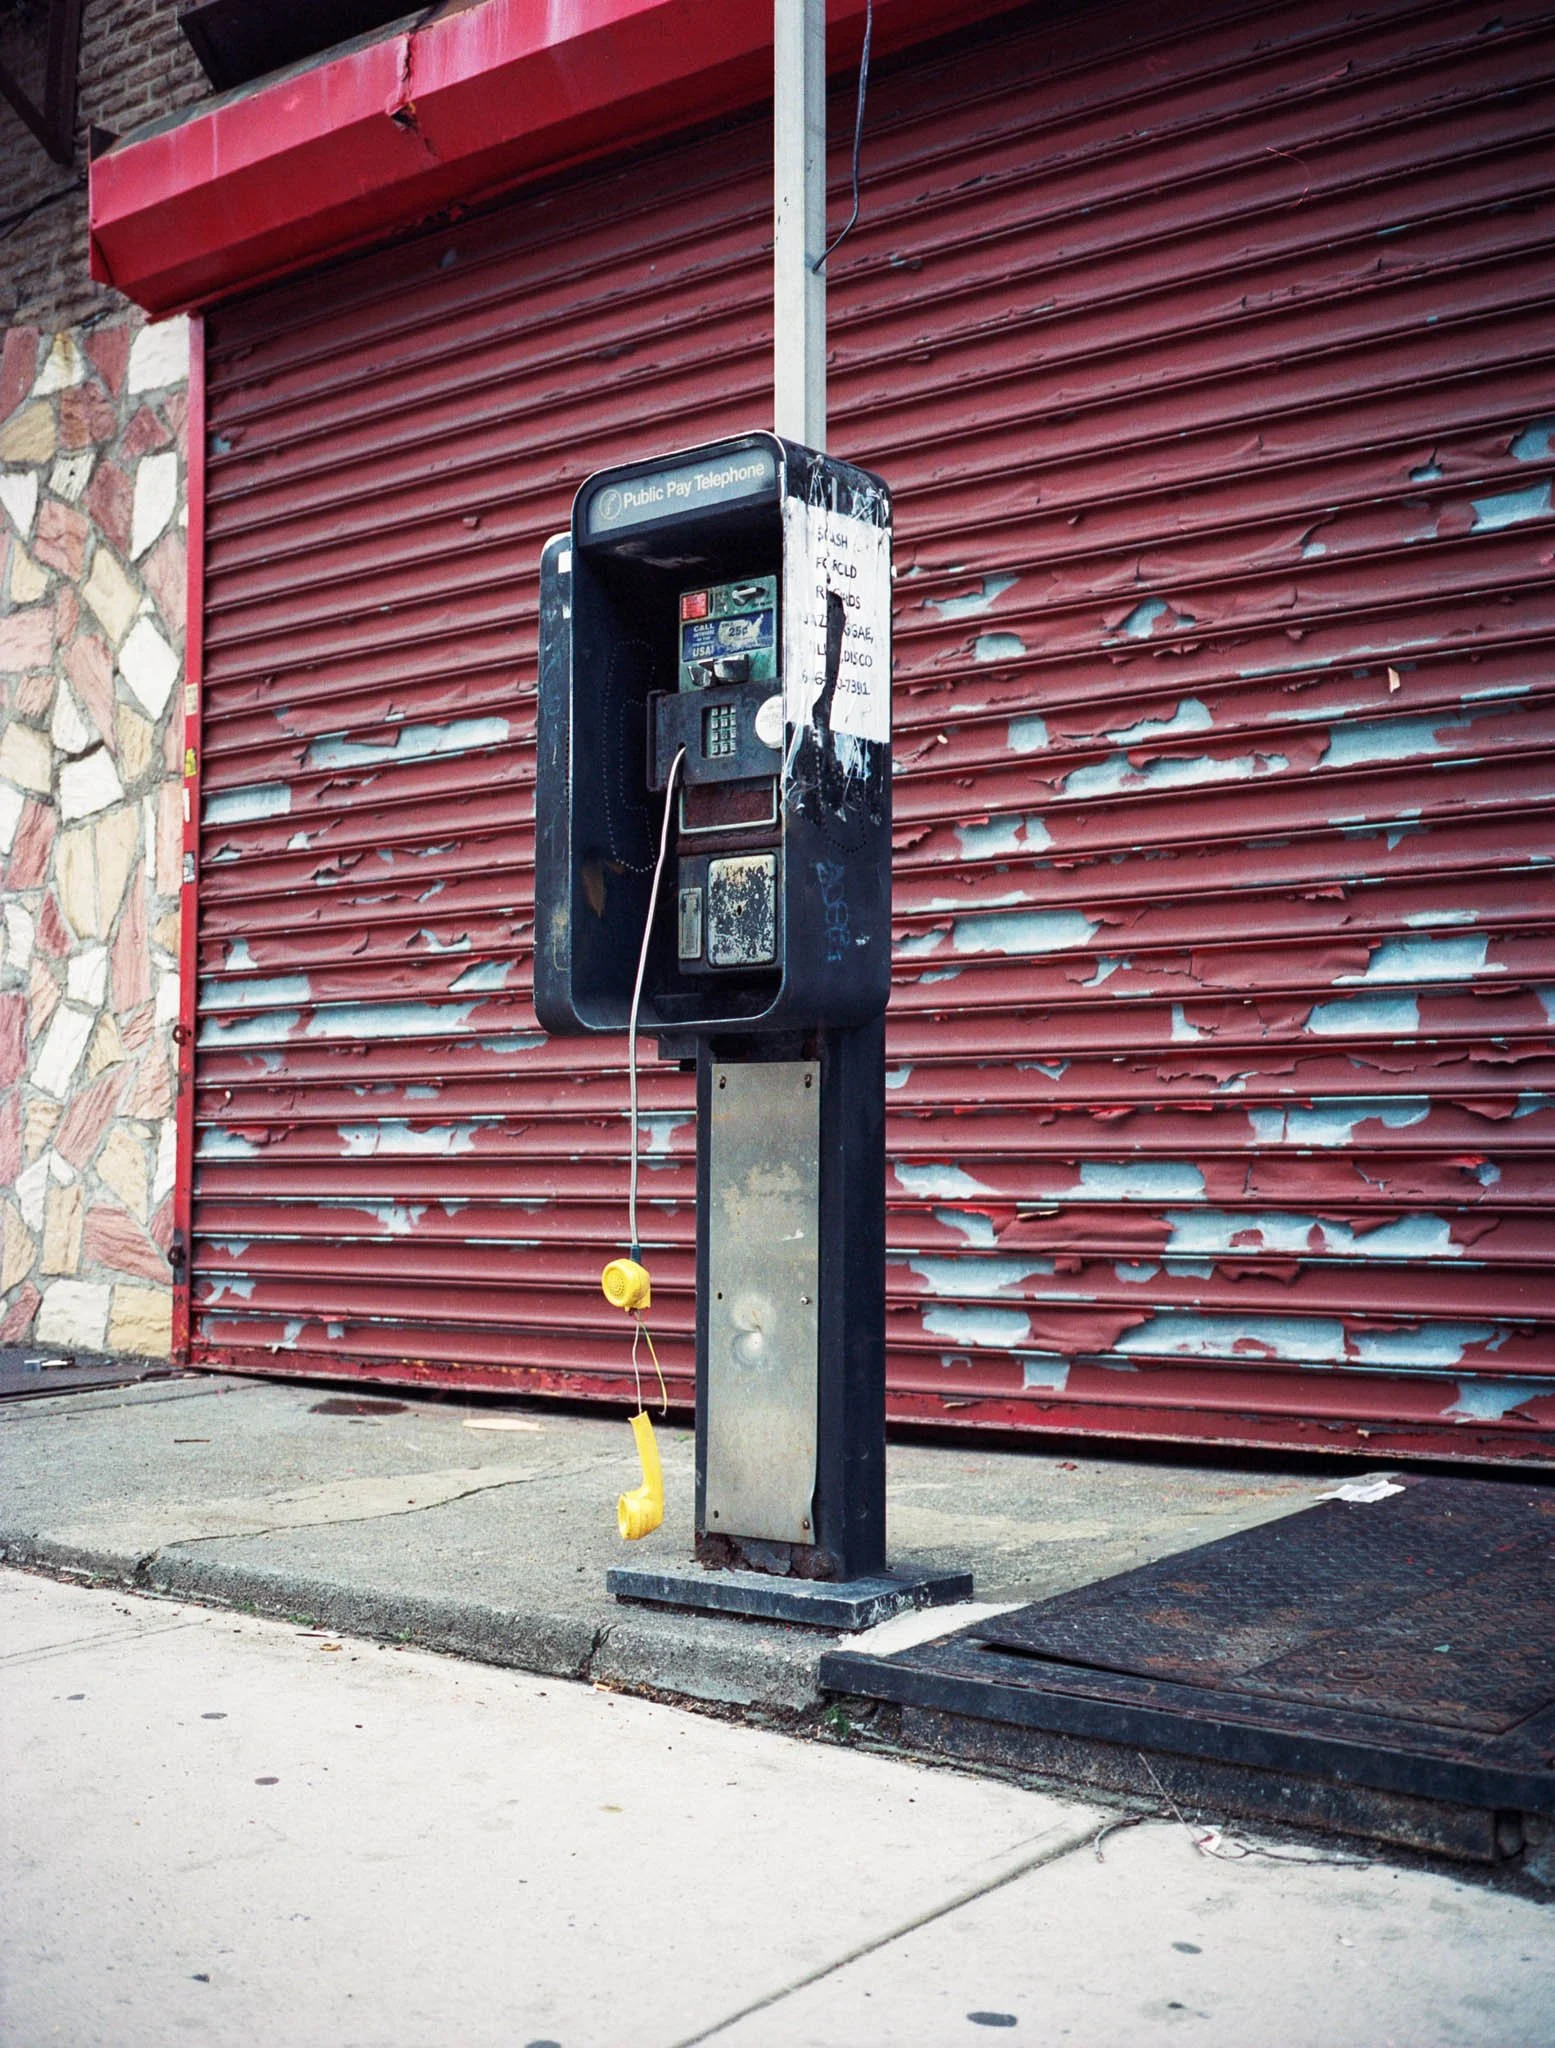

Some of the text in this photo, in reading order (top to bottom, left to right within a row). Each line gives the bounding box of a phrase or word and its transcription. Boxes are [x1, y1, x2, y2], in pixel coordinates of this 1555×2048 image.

[624, 463, 765, 509] Public Pay Telephone
[693, 623, 715, 632] CALL
